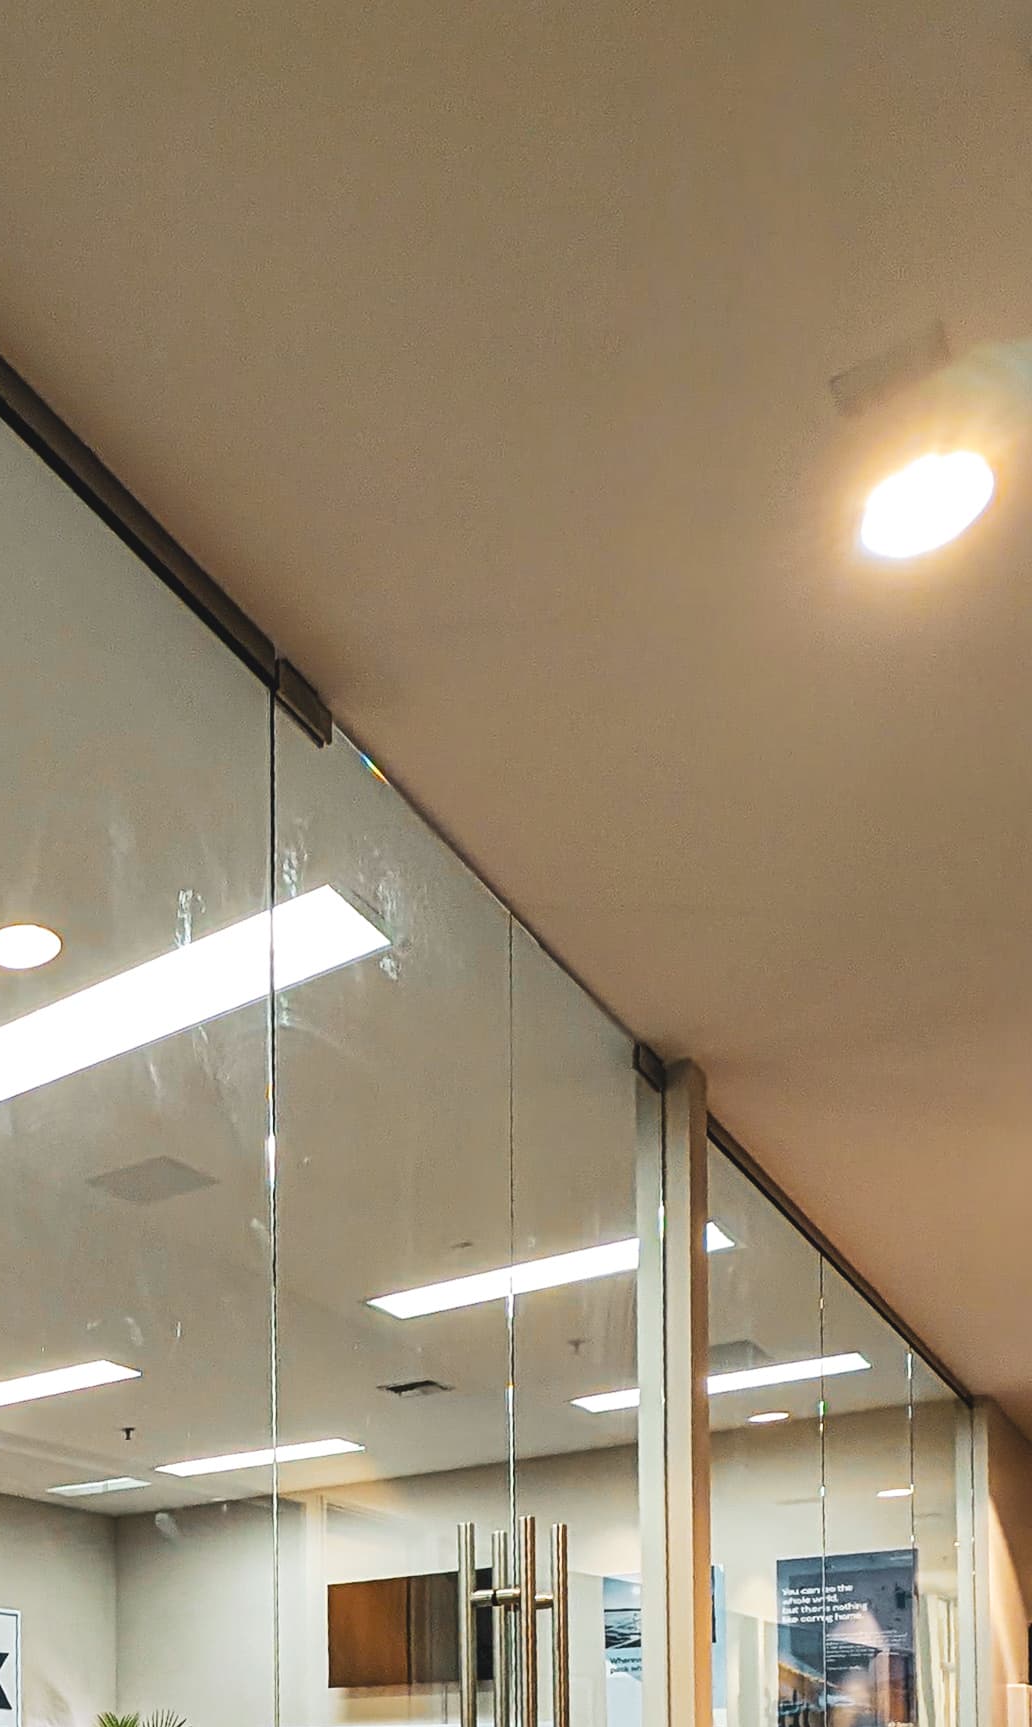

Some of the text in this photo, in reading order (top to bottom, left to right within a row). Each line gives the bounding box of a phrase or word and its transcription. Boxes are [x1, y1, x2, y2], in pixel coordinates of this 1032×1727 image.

[782, 1588, 799, 1596] You
[800, 1587, 820, 1595] can
[837, 1584, 853, 1593] the
[801, 1605, 830, 1613] thers
[832, 1602, 867, 1611] nothing
[800, 1614, 834, 1624] comg
